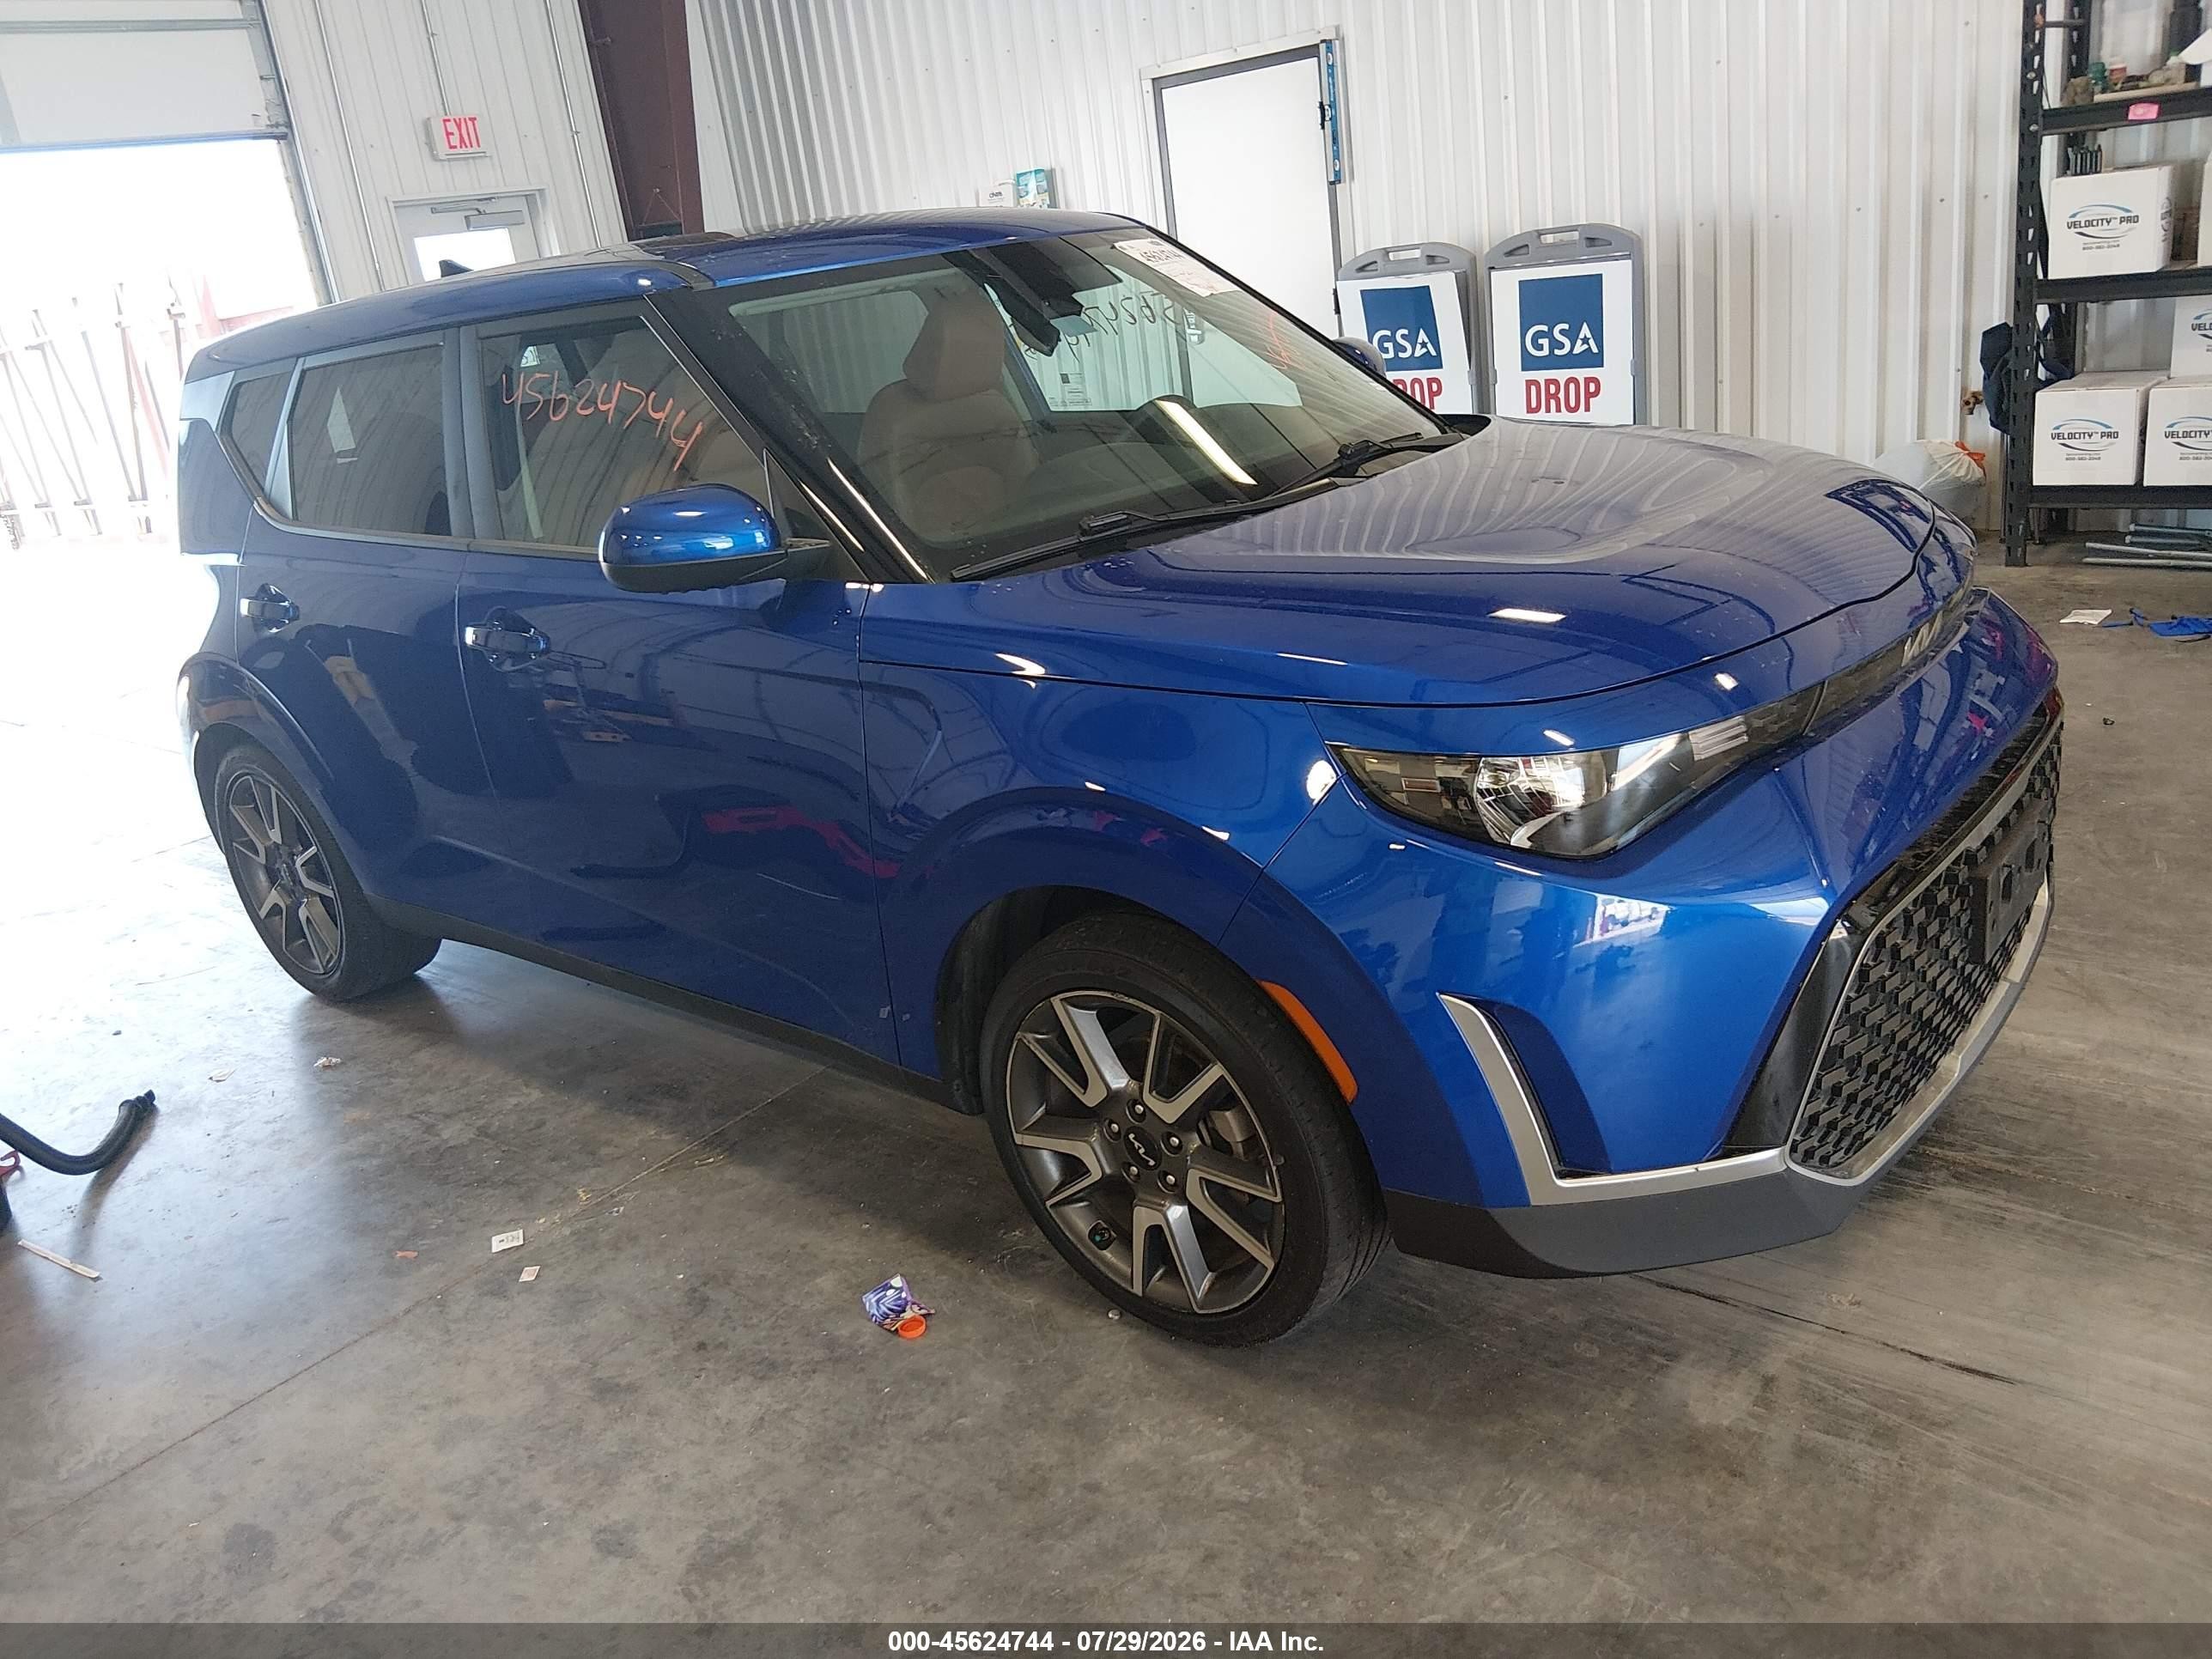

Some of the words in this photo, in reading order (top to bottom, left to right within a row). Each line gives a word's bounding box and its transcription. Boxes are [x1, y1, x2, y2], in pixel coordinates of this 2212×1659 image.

[442, 117, 481, 149] EXIT
[2119, 214, 2140, 225] PRO
[1372, 328, 1437, 359] GSA
[1525, 321, 1599, 357] GSA
[1525, 376, 1601, 414] DROP
[501, 371, 704, 472] 45624744
